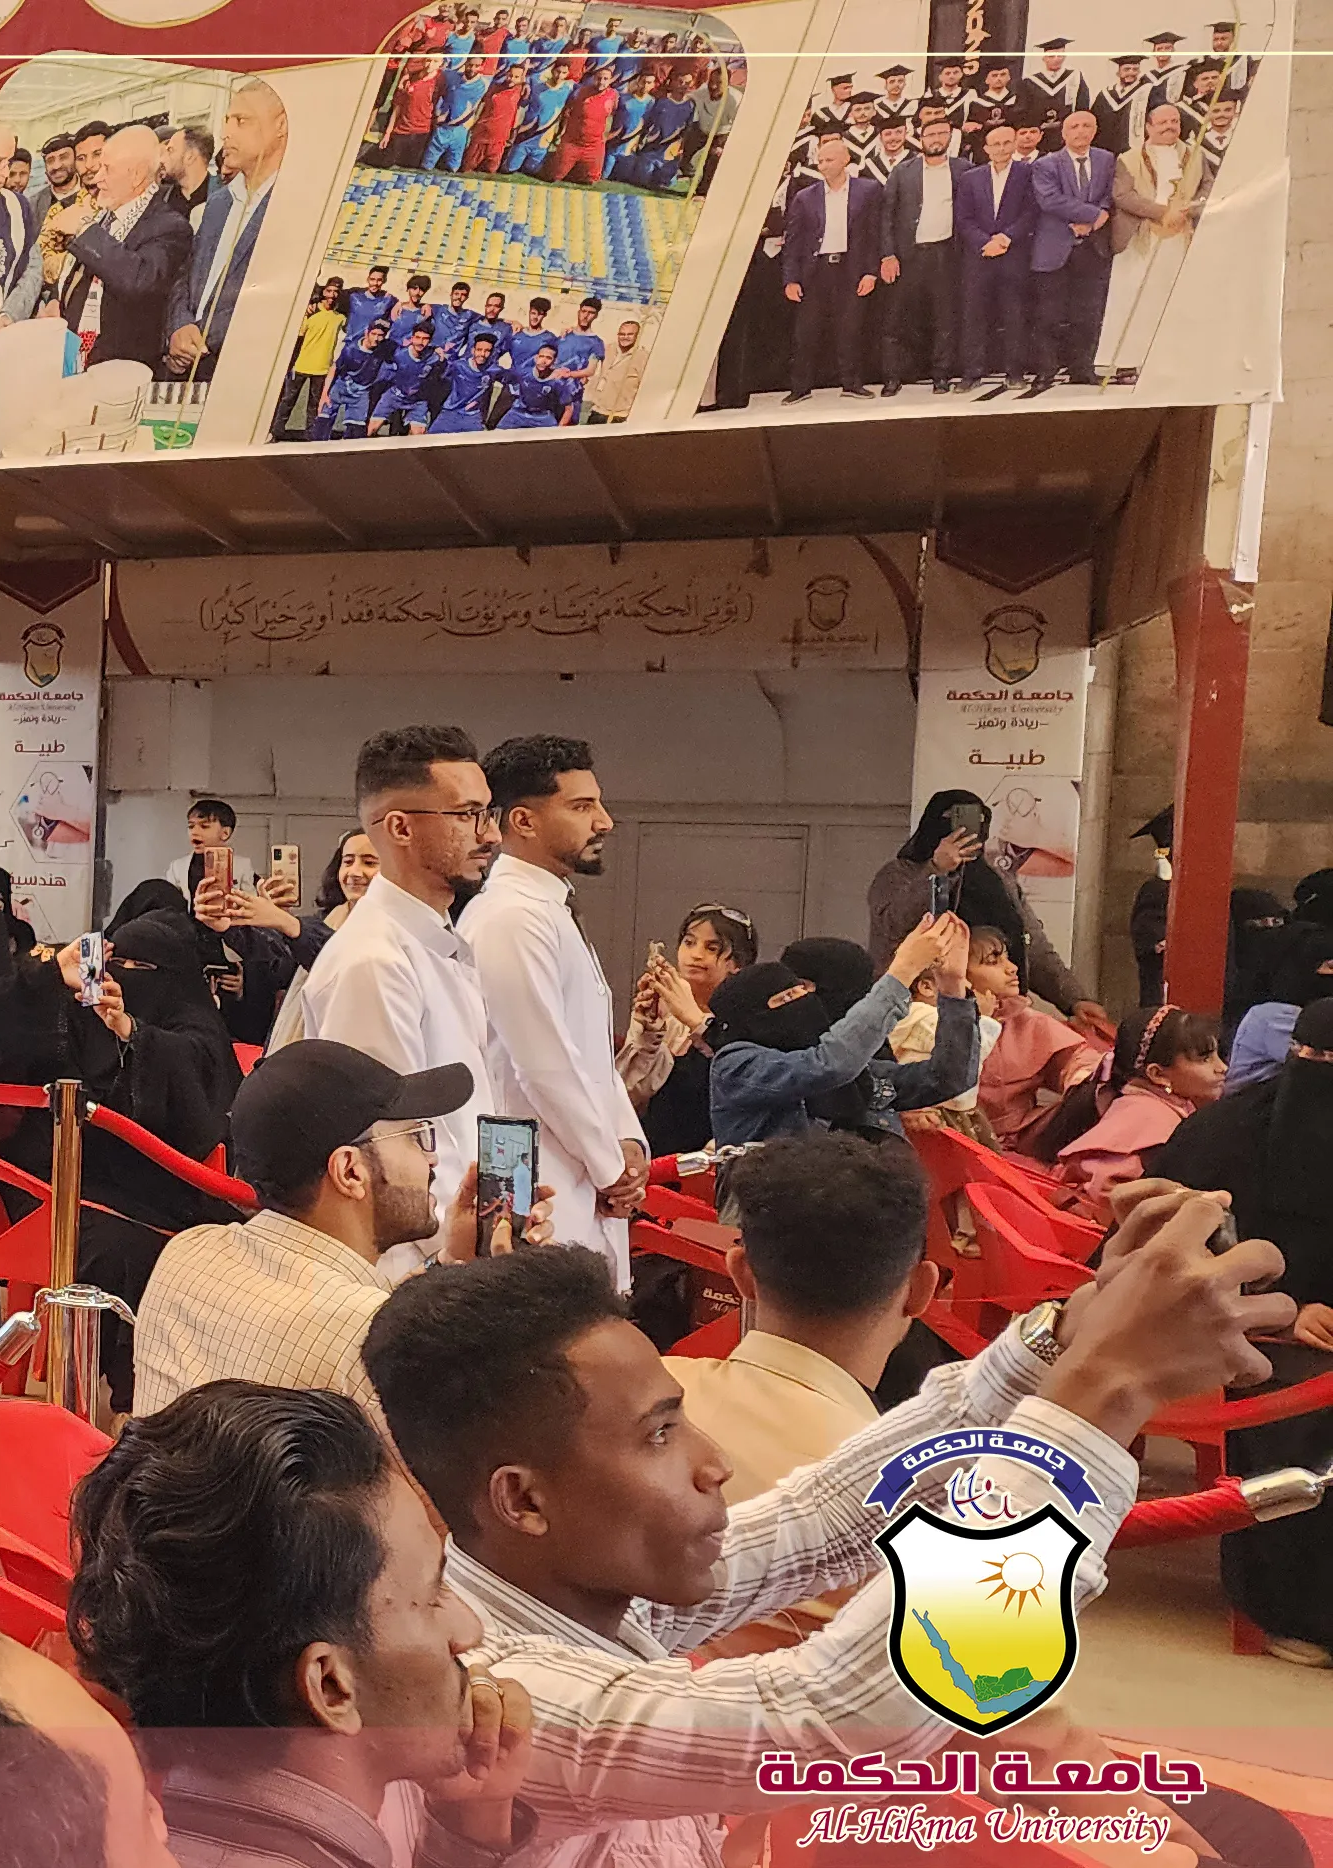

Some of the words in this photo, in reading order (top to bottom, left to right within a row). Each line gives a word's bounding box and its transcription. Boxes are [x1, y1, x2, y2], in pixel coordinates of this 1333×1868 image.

[43, 691, 84, 702] جامعة
[946, 690, 1009, 701] الحكمة
[1012, 690, 1074, 702] جامعة
[15, 740, 66, 757] طبية
[969, 750, 1046, 770] طبية
